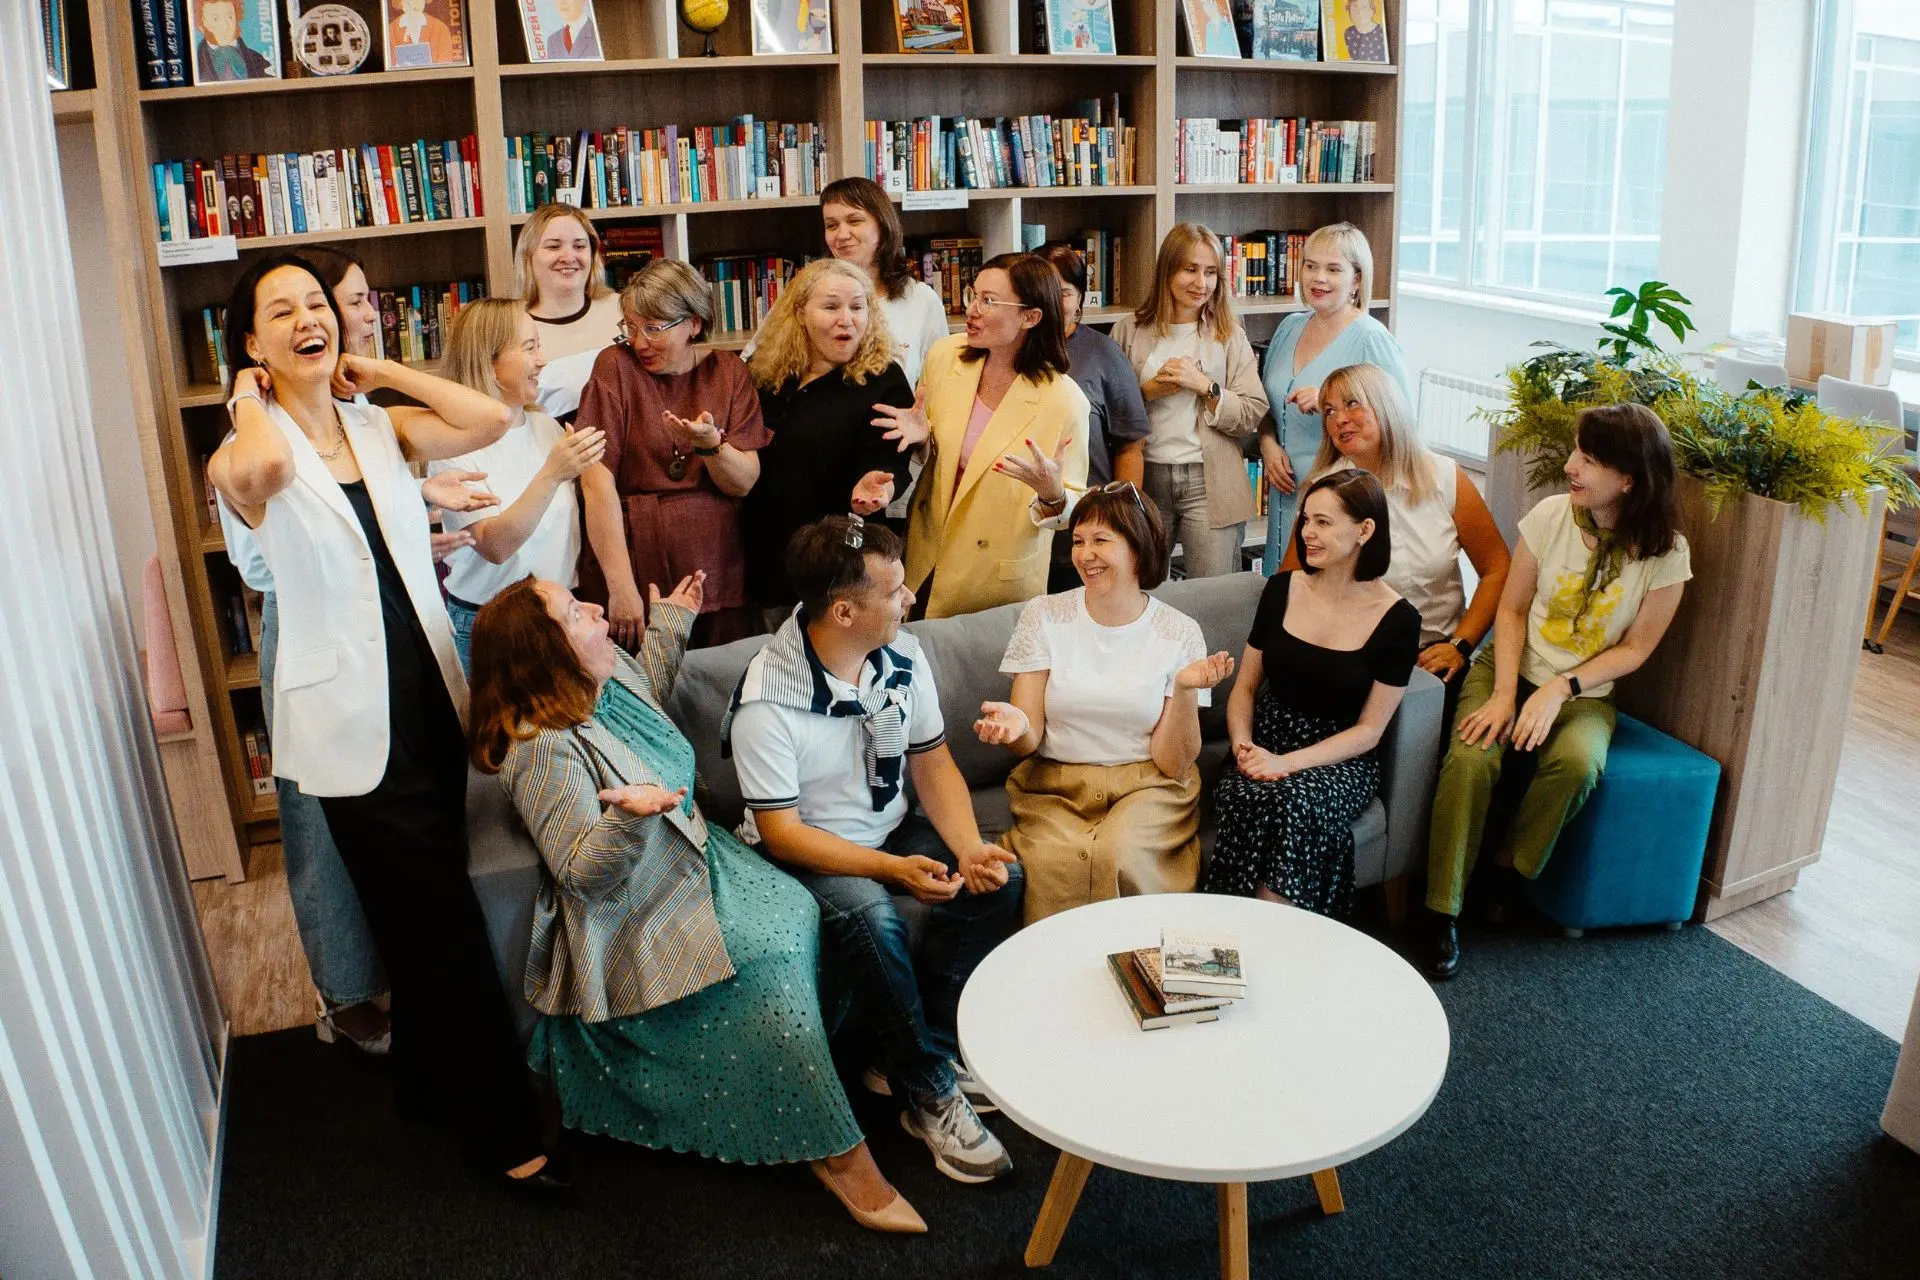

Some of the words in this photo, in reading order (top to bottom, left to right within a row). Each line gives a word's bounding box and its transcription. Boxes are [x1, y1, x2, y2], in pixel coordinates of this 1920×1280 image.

[528, 15, 547, 59] СЕРГЕЙ
[289, 167, 302, 206] АКСЕНОВ
[765, 182, 774, 192] Н
[892, 177, 901, 187] Б
[1090, 296, 1099, 305] Д
